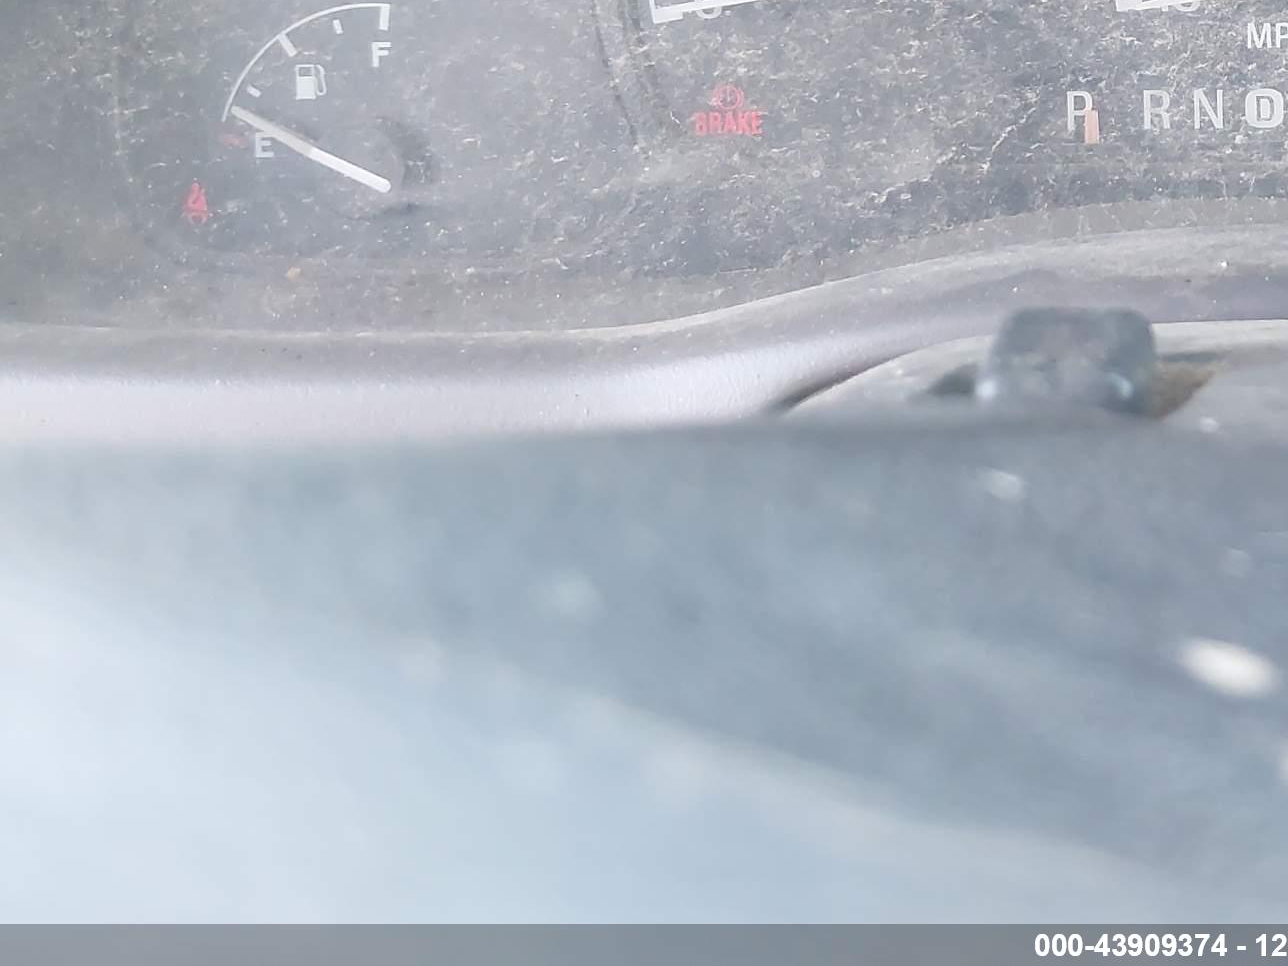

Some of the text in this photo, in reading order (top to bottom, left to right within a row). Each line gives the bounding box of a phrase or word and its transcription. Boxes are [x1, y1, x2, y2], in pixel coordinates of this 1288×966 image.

[371, 41, 392, 68] F
[694, 111, 763, 136] BRAKE
[1066, 90, 1093, 132] P
[1143, 89, 1171, 130] R
[1193, 89, 1224, 130] N
[255, 133, 275, 159] E
